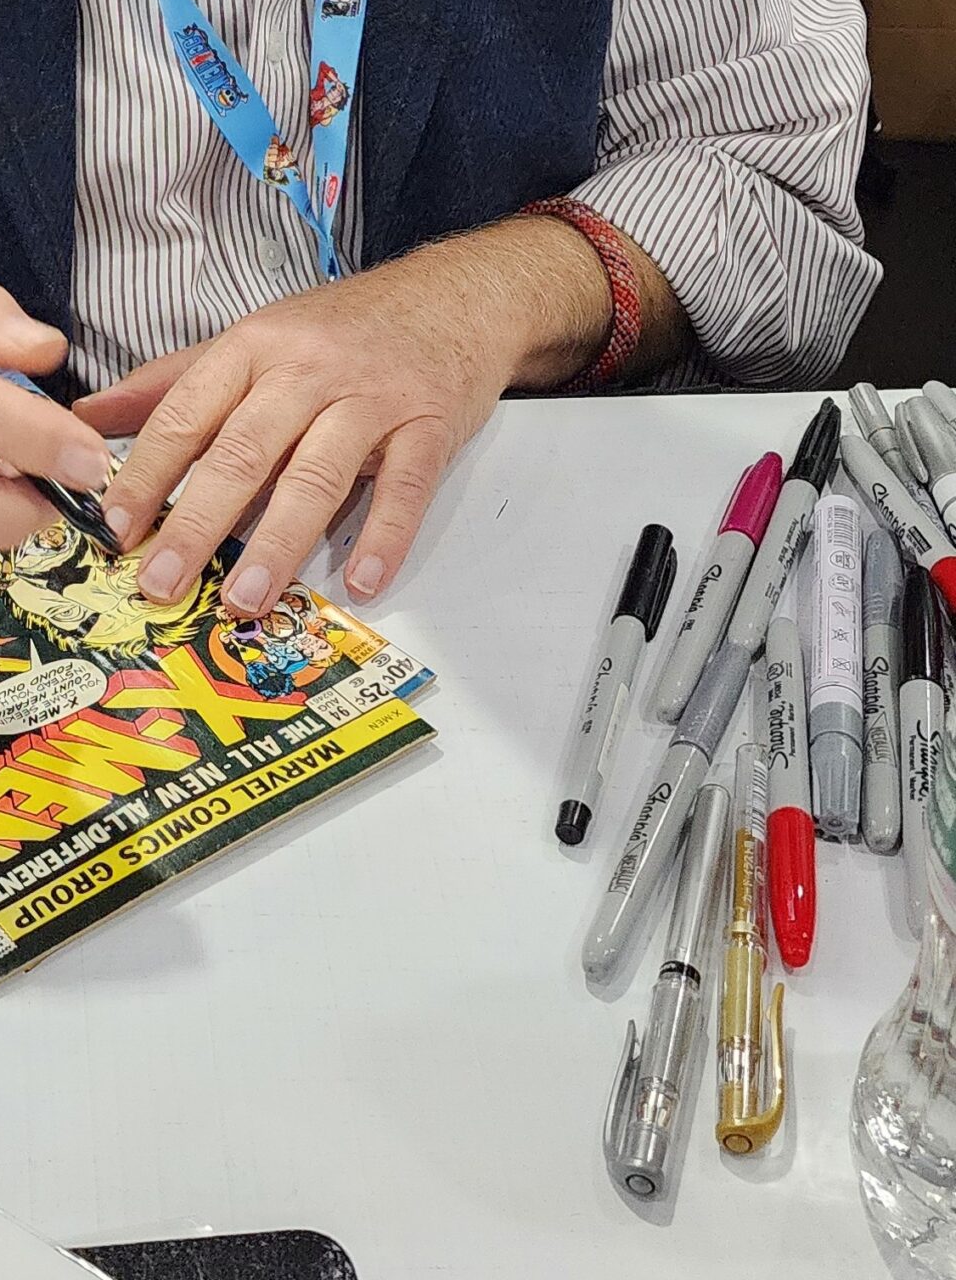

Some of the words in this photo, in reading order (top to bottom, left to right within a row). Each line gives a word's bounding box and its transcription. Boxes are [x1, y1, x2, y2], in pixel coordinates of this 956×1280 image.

[28, 661, 74, 686] FOUND
[34, 664, 86, 692] INSTEAD
[49, 671, 92, 696] COUNT
[78, 676, 102, 692] YOU
[10, 687, 34, 702] YOU
[41, 688, 77, 708] CAME
[315, 696, 339, 712] AUG
[354, 680, 389, 706] 25¢
[327, 704, 350, 721] 94
[366, 708, 403, 731] X-MEN
[276, 715, 326, 745] THE
[767, 702, 789, 770] Sharpie
[909, 734, 917, 771] Permanent
[229, 738, 345, 802] MARVEL
[909, 776, 917, 801] Marker
[628, 783, 671, 842] Sharpie
[116, 794, 232, 868] COMICS
[13, 858, 115, 930] GROUP
